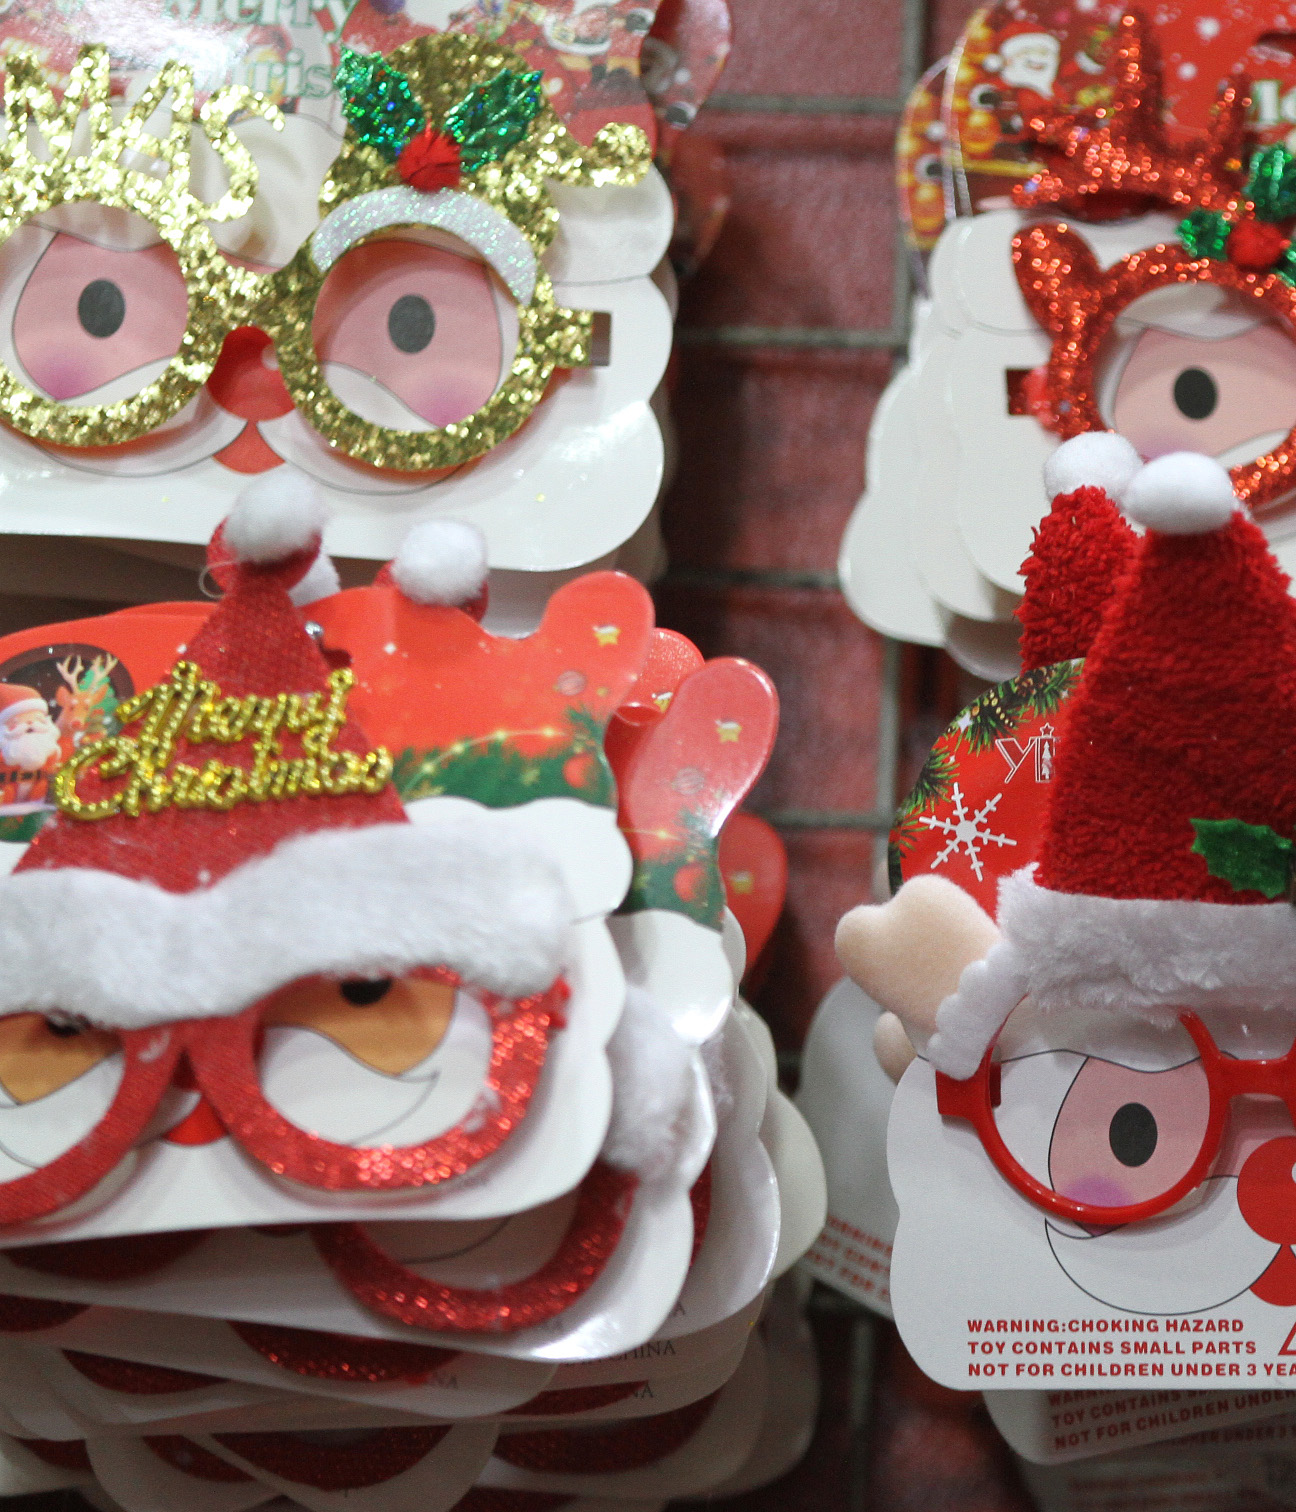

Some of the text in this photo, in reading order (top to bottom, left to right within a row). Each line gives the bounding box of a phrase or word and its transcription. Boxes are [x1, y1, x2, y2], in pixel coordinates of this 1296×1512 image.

[116, 660, 357, 768] Merry
[54, 735, 394, 822] Christmas
[1165, 1319, 1244, 1332] HAZARD
[967, 1341, 1257, 1355] TOY CONTAINS SMALL PARTS
[968, 1363, 1009, 1377] NOT
[1015, 1363, 1055, 1377] FOR
[1060, 1363, 1164, 1377] CHILDREN
[1170, 1363, 1241, 1377] UNDER
[1246, 1363, 1257, 1377] 3
[1096, 1421, 1132, 1440] FOR
[1136, 1400, 1230, 1431] CHILDREN
